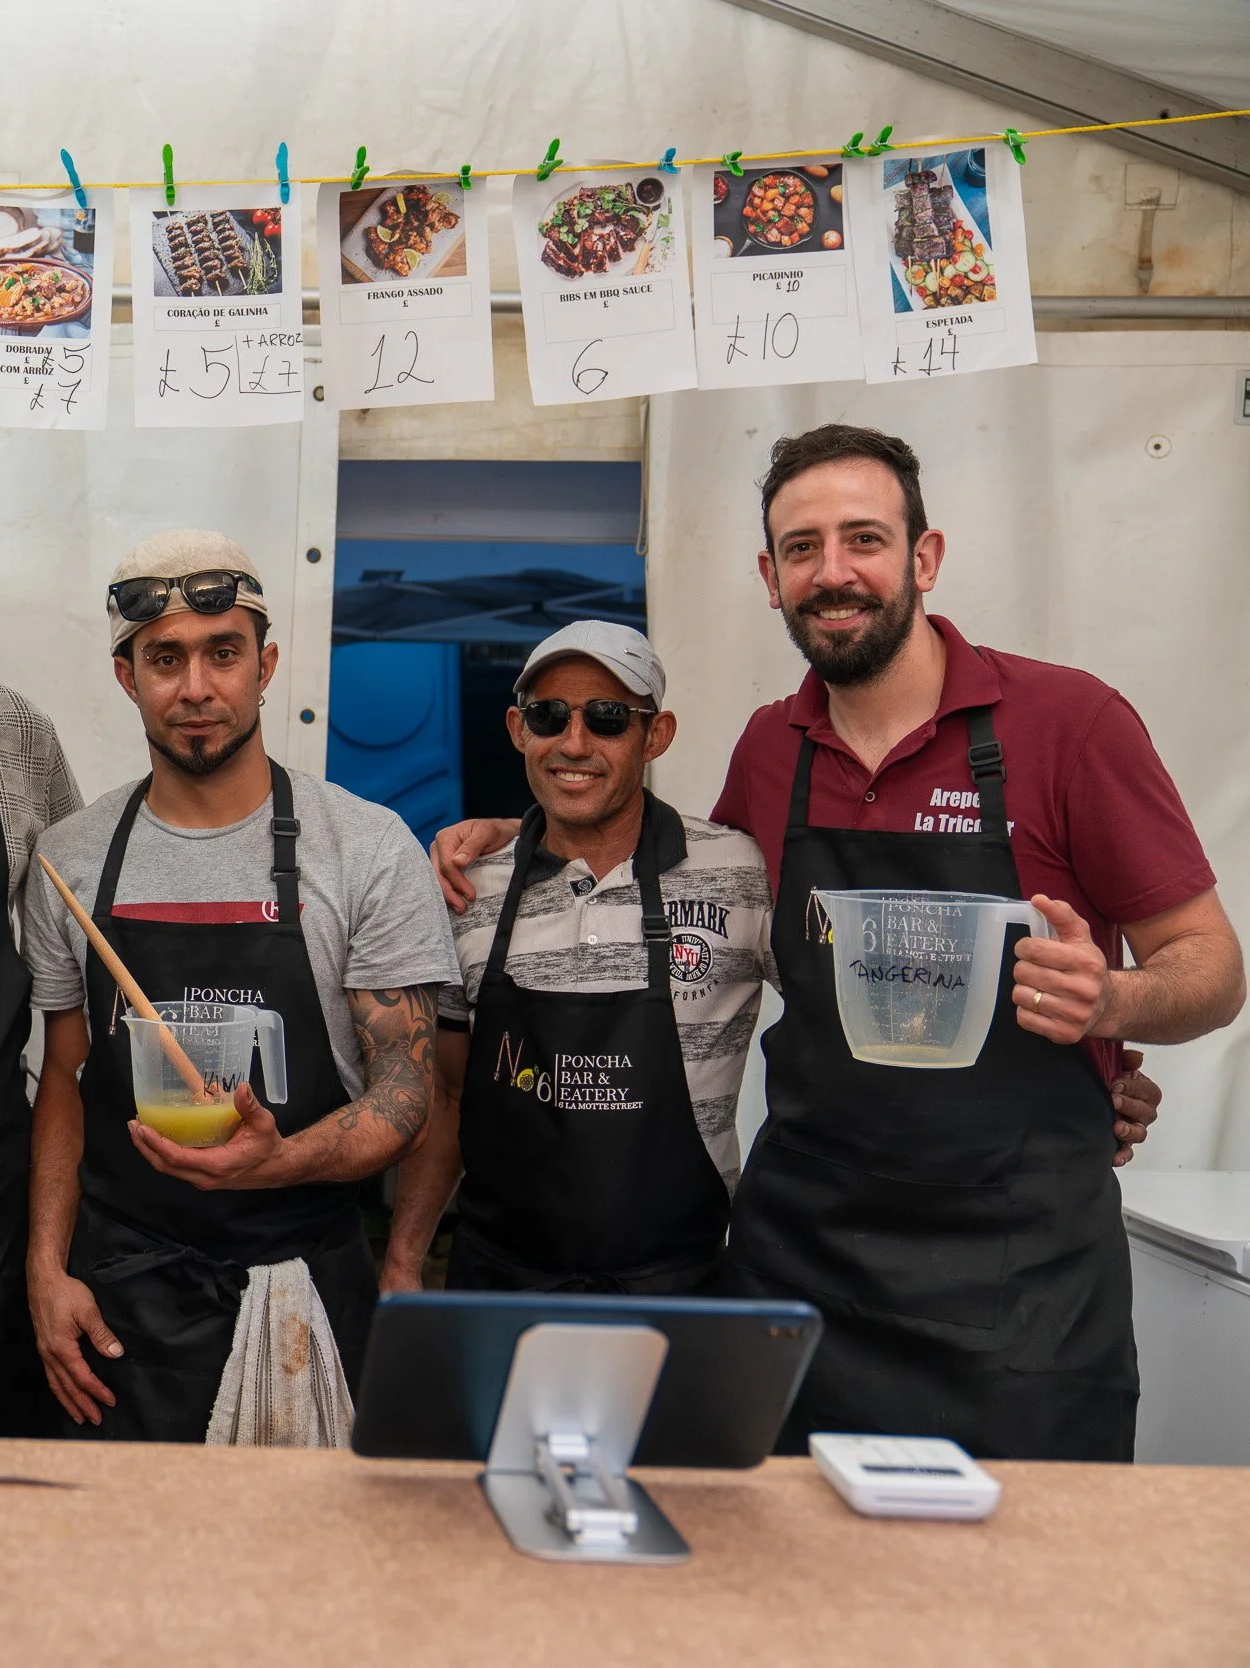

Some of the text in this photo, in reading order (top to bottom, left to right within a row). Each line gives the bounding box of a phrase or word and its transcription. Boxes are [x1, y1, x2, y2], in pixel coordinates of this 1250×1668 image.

[752, 270, 804, 281] PICADINHO
[786, 279, 800, 293] 10
[367, 287, 443, 300] FRANGO ASSADO
[559, 284, 653, 303] RIBS EM BBQ SAUCE
[167, 308, 210, 319] CORAÇÃO
[228, 308, 268, 316] GALINHA
[926, 315, 973, 328] ESPETADA
[258, 333, 303, 347] ARROZ
[6, 345, 50, 355] DOBRADA
[364, 330, 435, 394] 12
[572, 339, 608, 395] 6
[0, 365, 54, 375] COM ARROZ
[914, 813, 934, 831] La
[662, 900, 730, 939] RMARK
[886, 915, 940, 934] BAR &
[886, 931, 958, 953] EATERY
[674, 944, 699, 966] NYU
[849, 960, 965, 990] TANGERINA
[190, 987, 265, 1003] PONCHA
[189, 1004, 223, 1019] BAR
[561, 1054, 633, 1068] PONCHA
[561, 1071, 610, 1085] BAR &
[561, 1087, 629, 1101] EATERY
[610, 1102, 643, 1110] STREET
